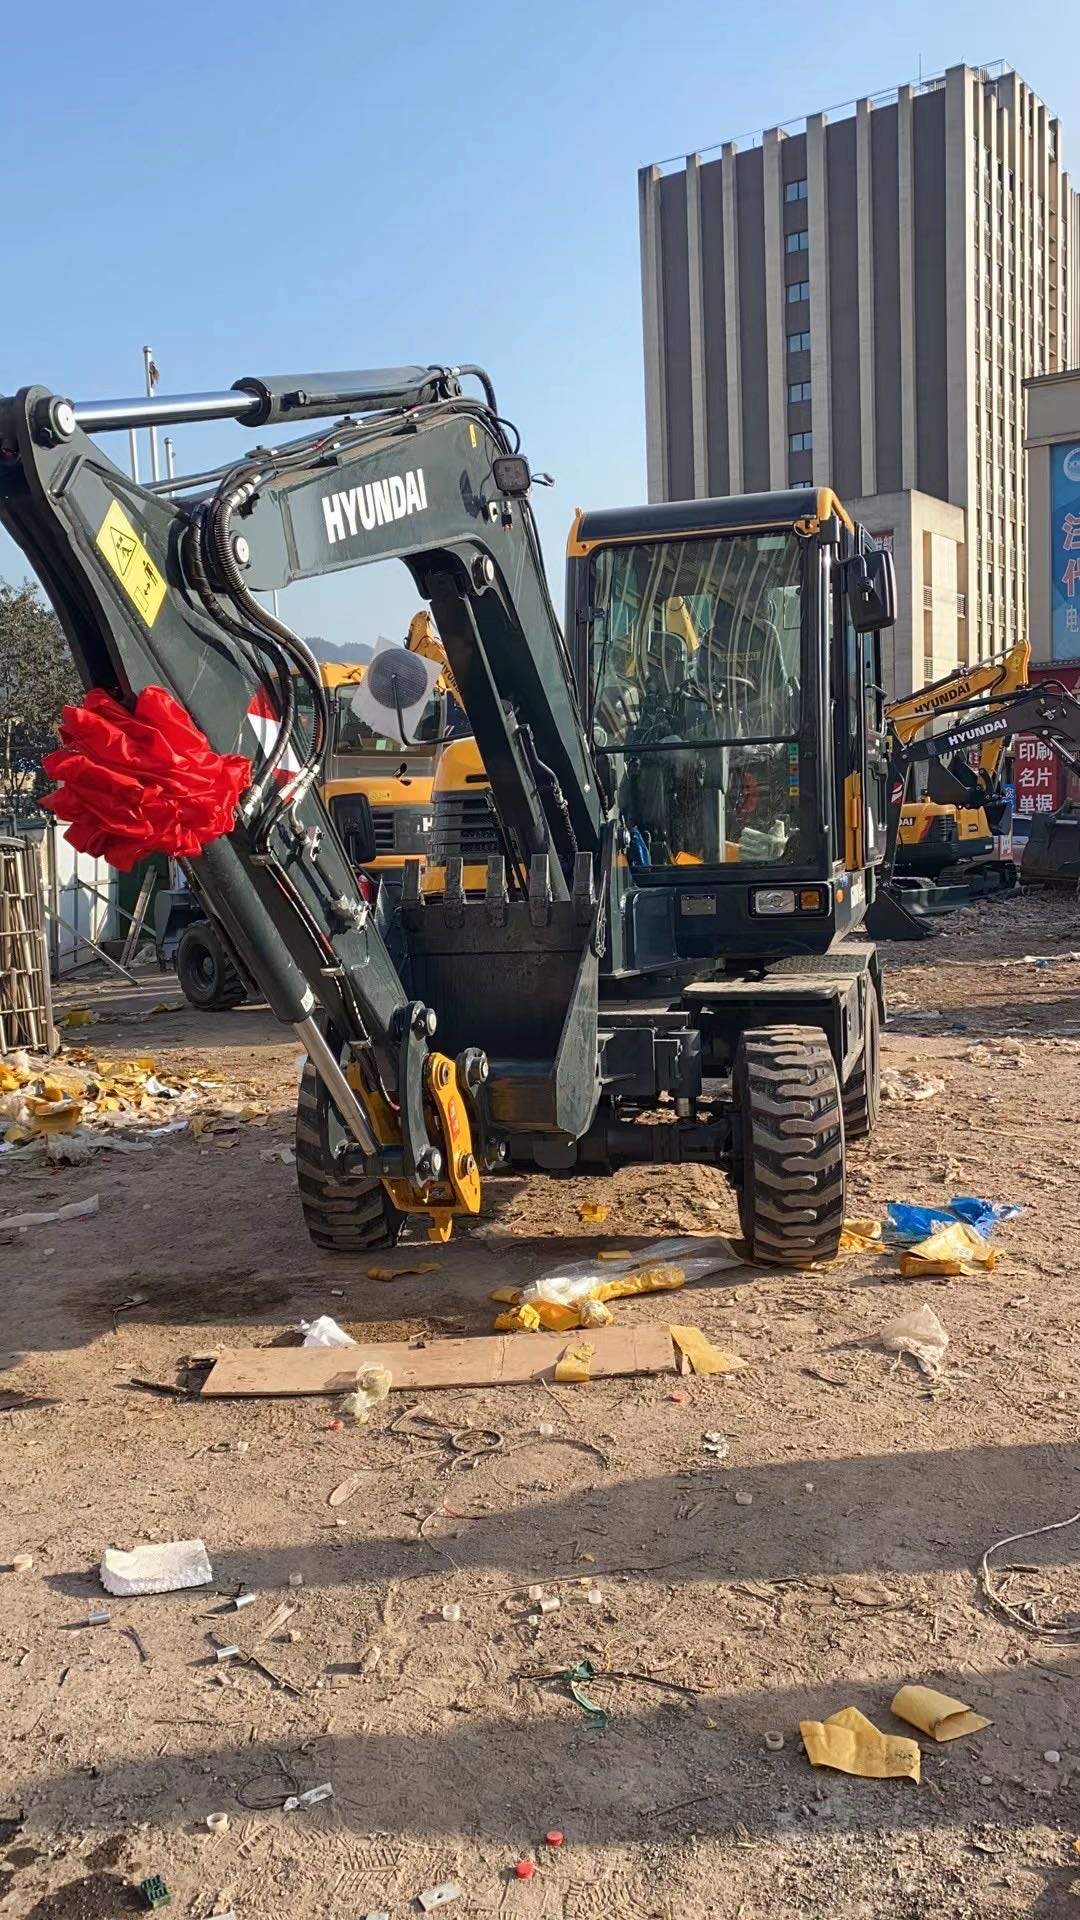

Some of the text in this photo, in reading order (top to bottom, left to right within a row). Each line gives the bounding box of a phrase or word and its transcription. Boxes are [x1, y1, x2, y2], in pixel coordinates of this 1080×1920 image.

[321, 468, 428, 544] HYUNDAI
[914, 682, 971, 714] HYUNDAI
[947, 718, 1009, 747] HYUNDAI
[1018, 741, 1054, 763] 印刷
[1018, 767, 1053, 788] 名片
[1018, 794, 1054, 815] 单据
